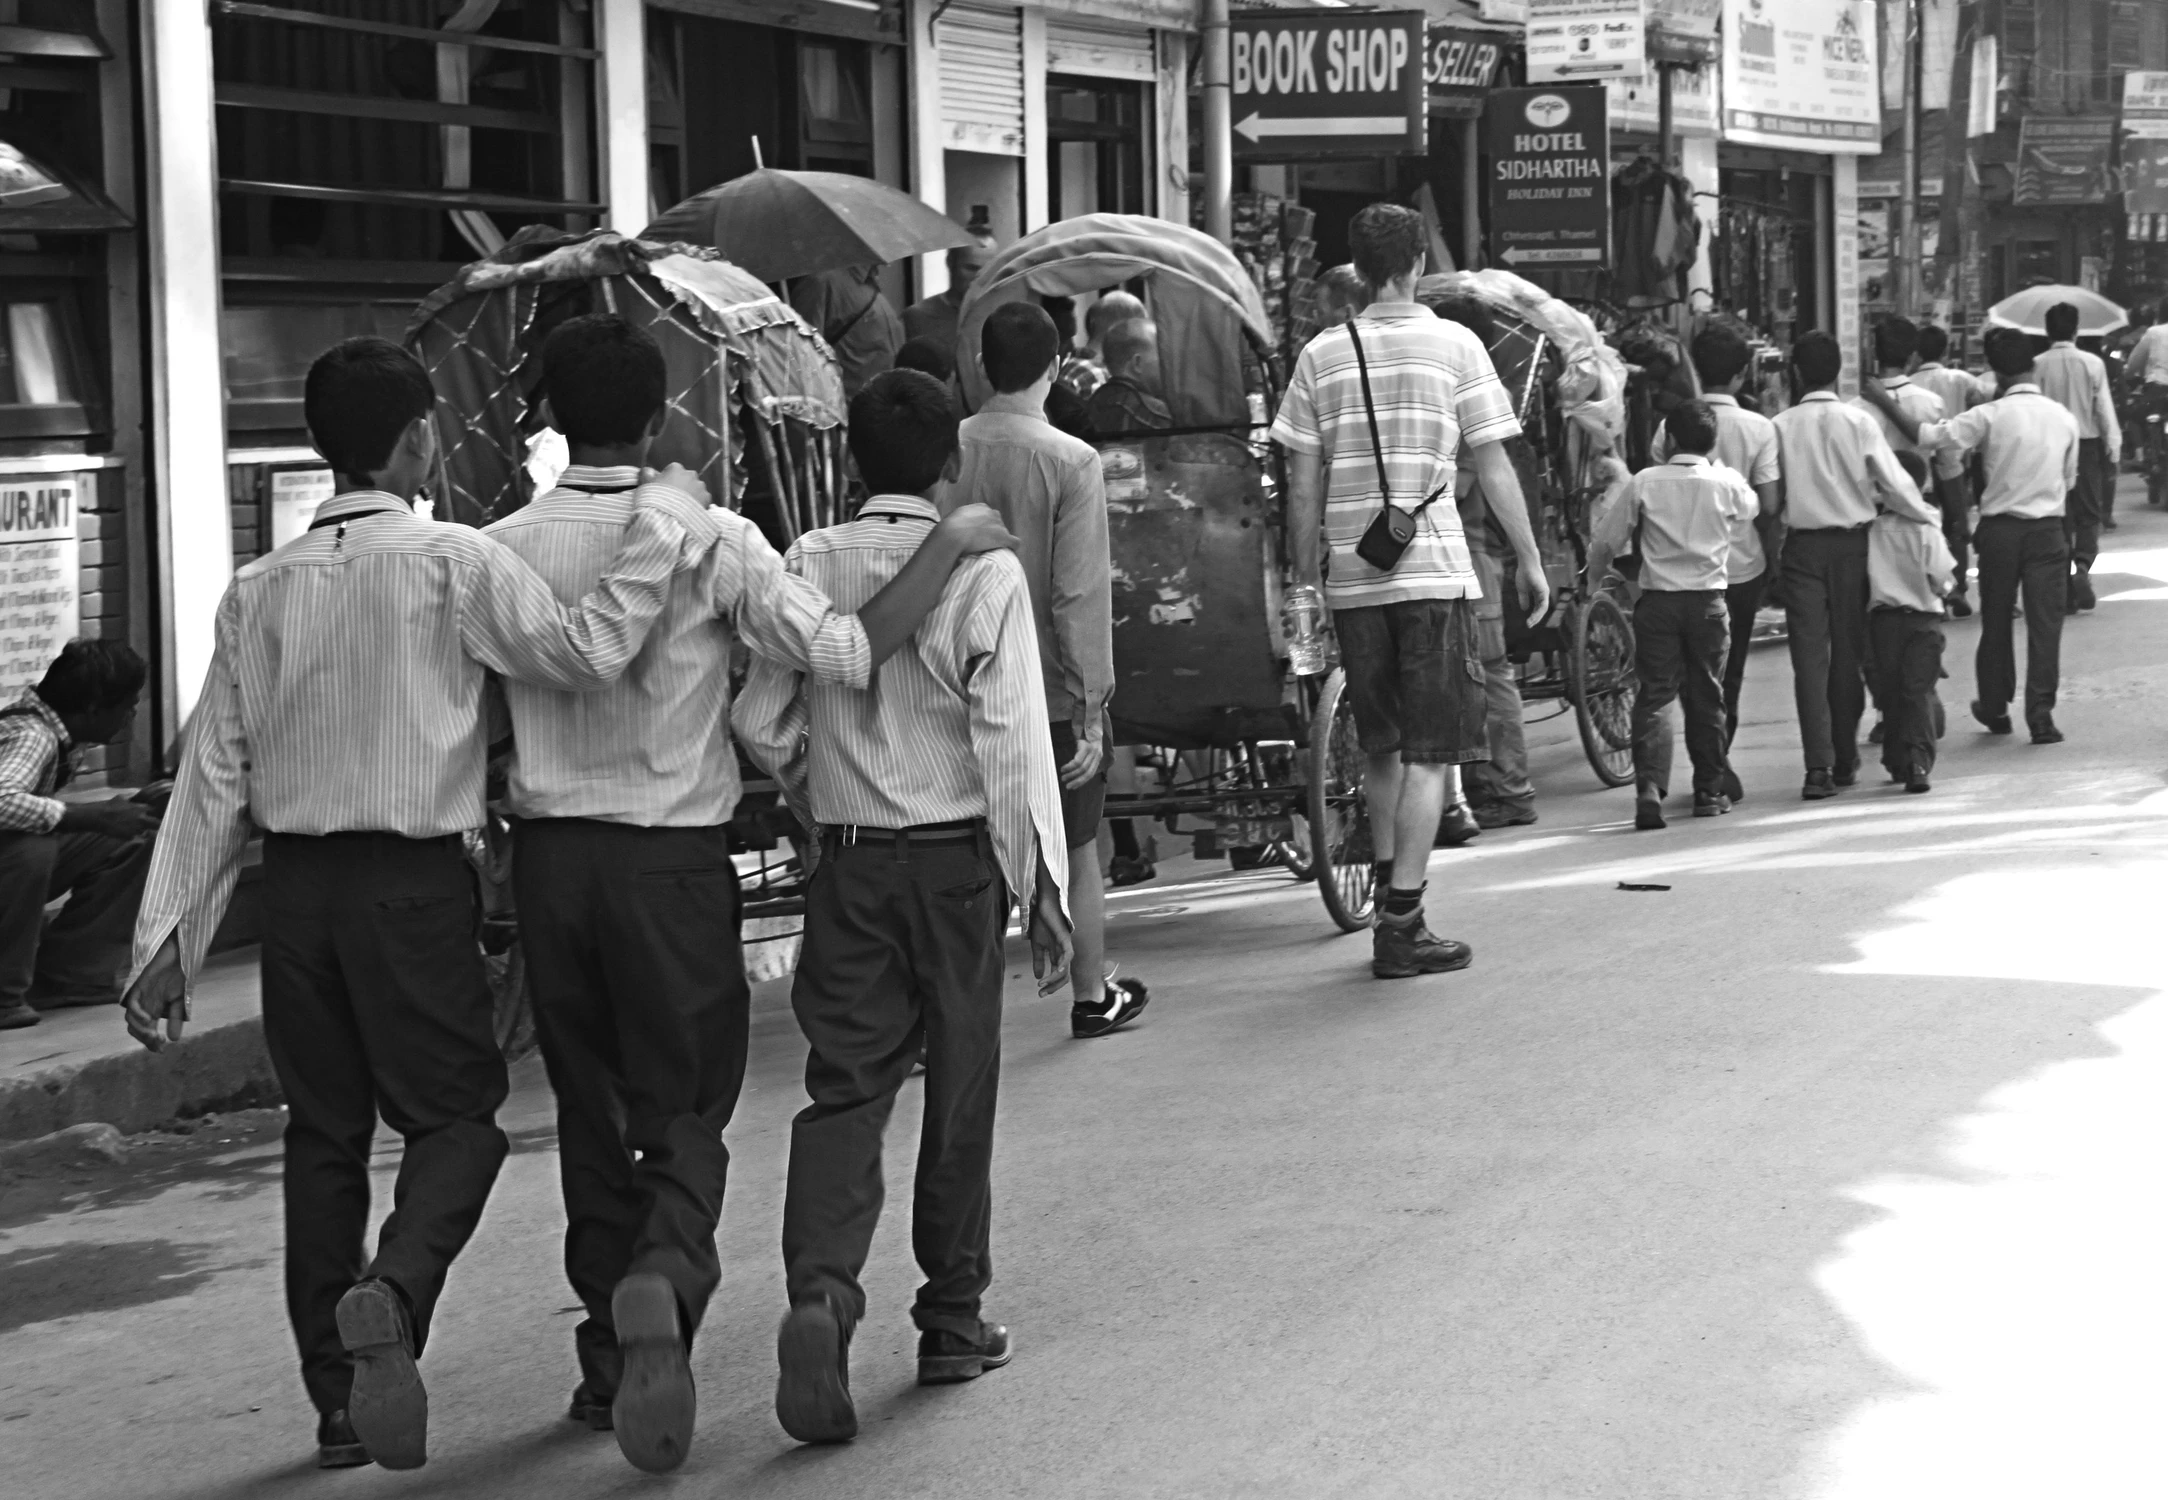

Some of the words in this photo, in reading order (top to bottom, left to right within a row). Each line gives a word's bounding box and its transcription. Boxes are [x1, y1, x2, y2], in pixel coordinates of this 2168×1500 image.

[1233, 30, 1318, 94] BOOK
[1326, 28, 1408, 93] SHOP
[1426, 40, 1497, 87] SELLER
[1514, 133, 1586, 152] HOTEL
[1496, 158, 1602, 180] SIDHARTHA
[1507, 188, 1565, 200] HOLIDAY
[1567, 187, 1593, 198] INN
